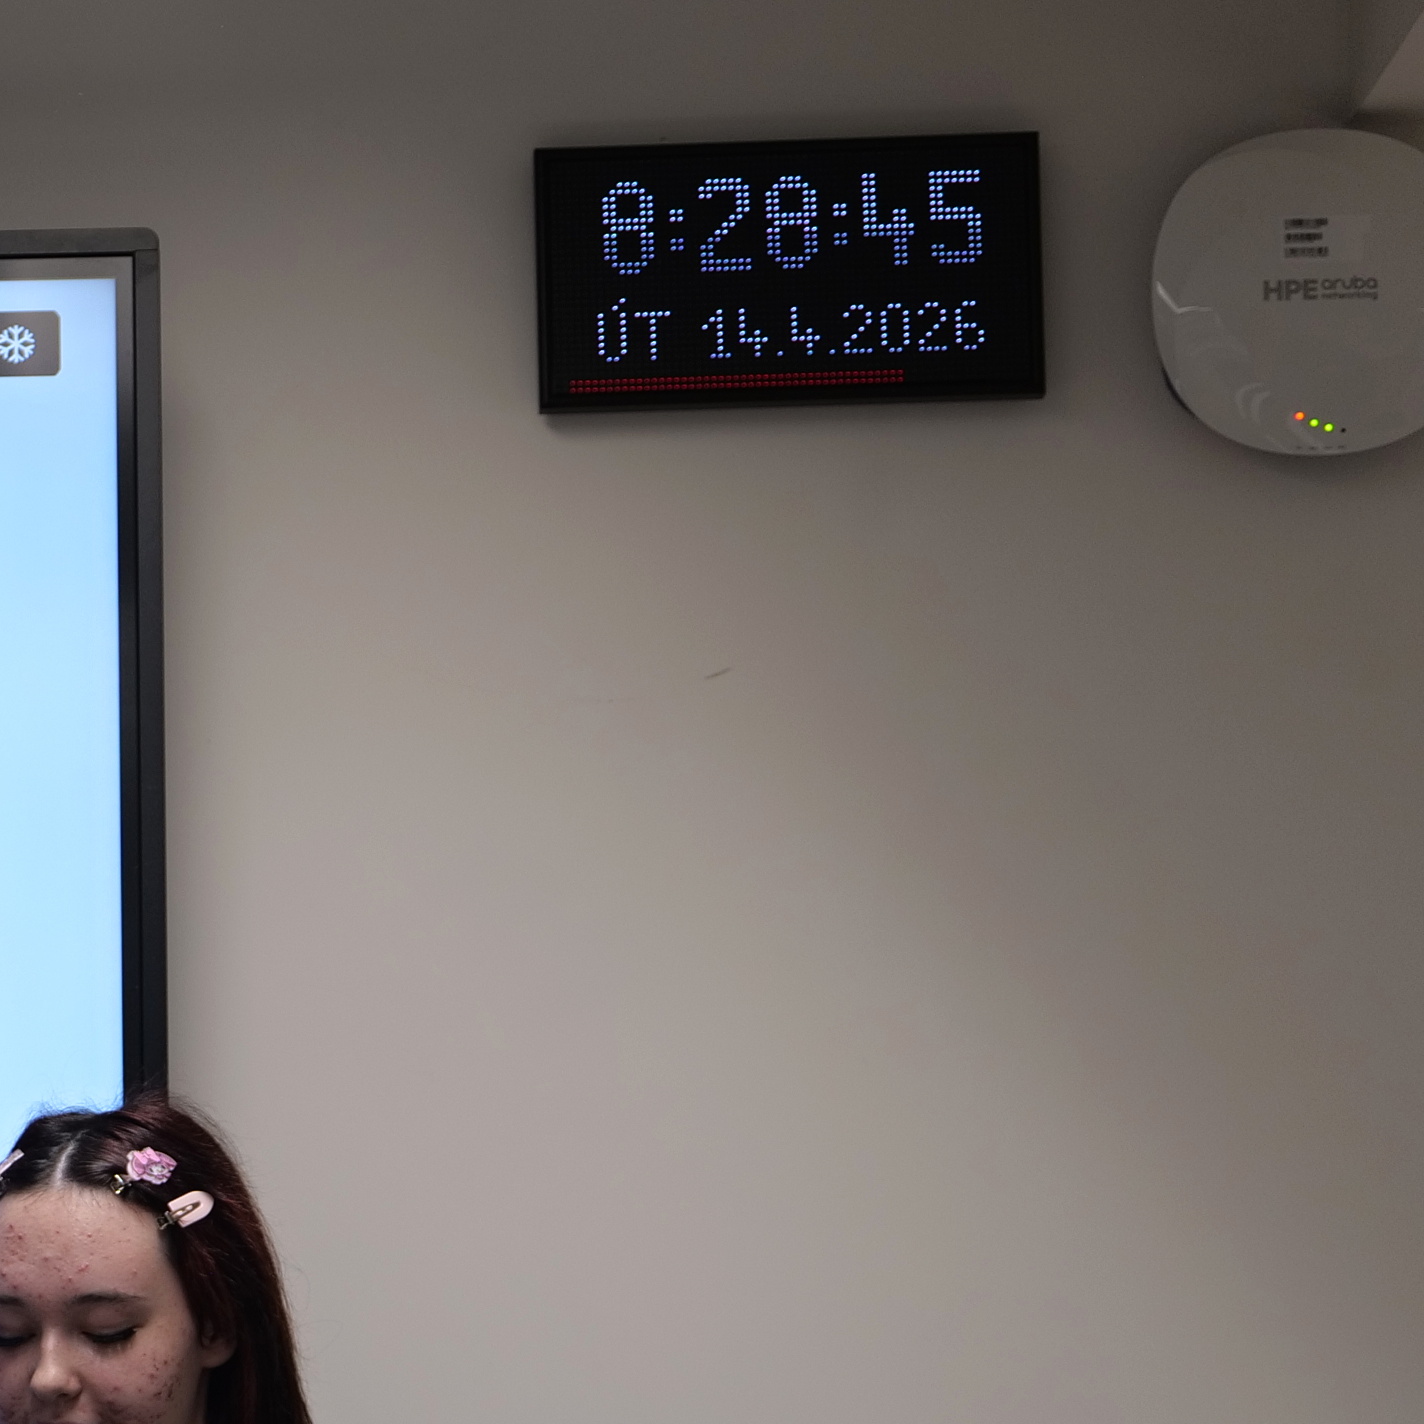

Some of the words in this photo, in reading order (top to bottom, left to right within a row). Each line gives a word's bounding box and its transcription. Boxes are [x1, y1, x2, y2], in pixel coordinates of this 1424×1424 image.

[601, 168, 984, 275] 8:28:45
[1263, 278, 1318, 301] HPE
[1320, 275, 1379, 290] aruba
[596, 297, 672, 363] ÚT
[700, 299, 986, 359] 14.4.2026
